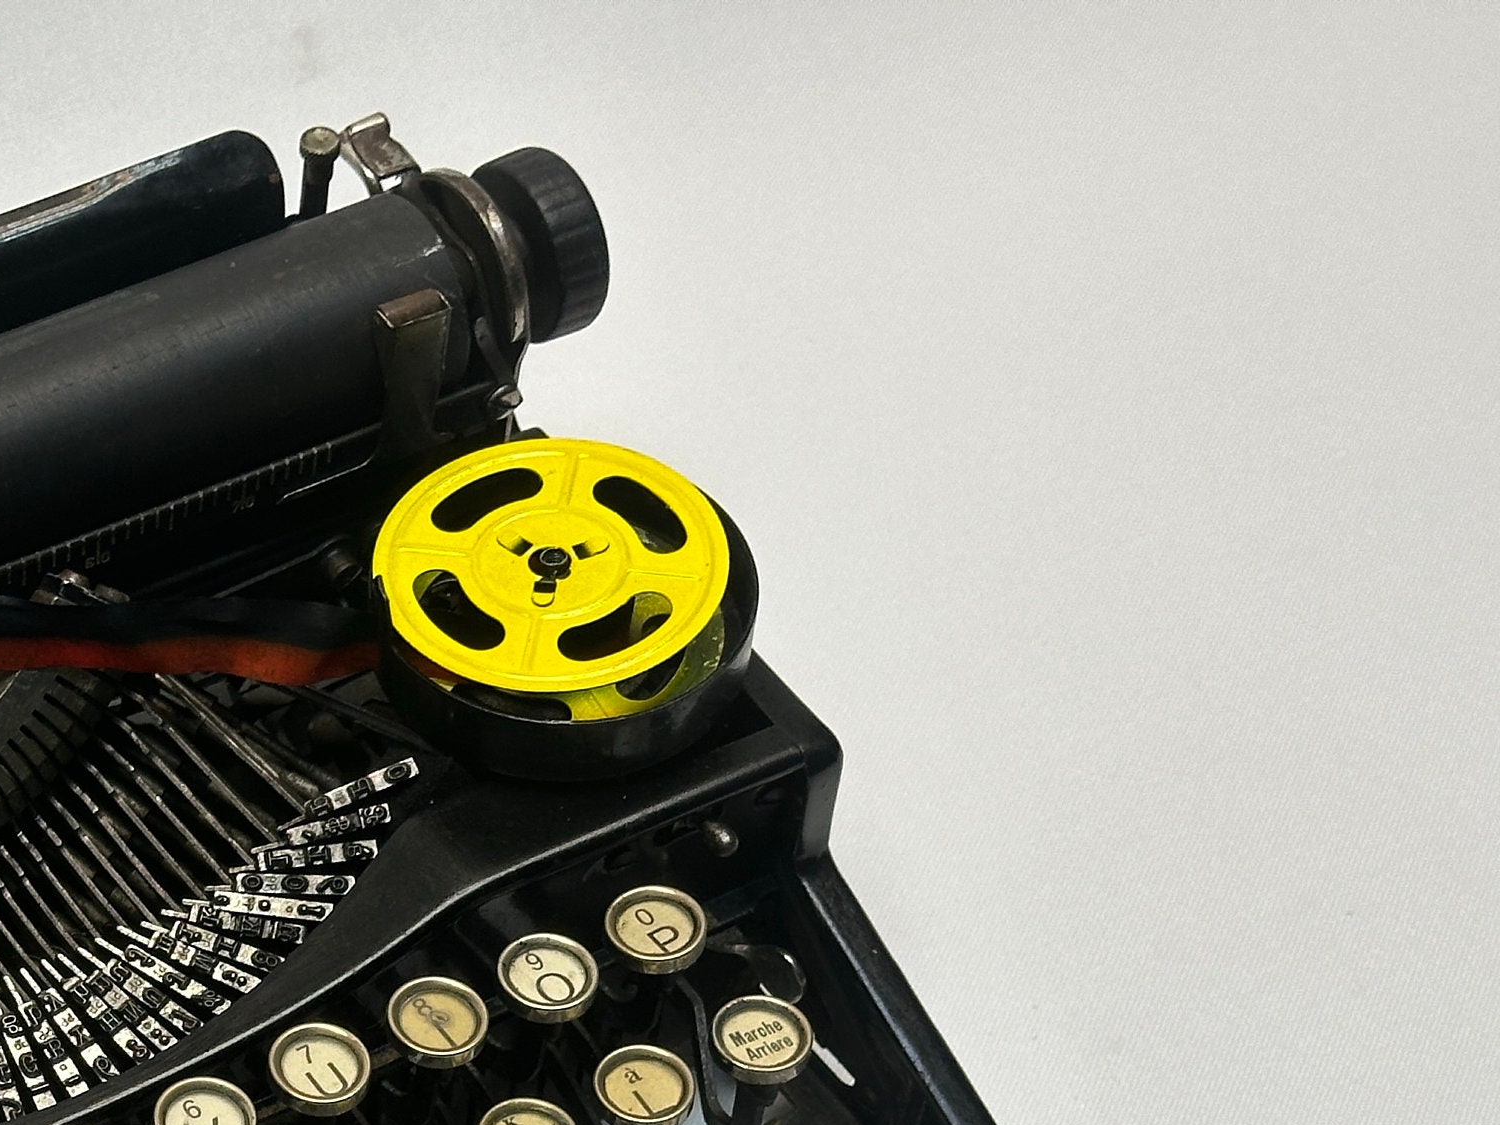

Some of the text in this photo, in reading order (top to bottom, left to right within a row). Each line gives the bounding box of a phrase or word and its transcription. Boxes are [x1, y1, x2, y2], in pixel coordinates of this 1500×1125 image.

[647, 925, 679, 953] P
[525, 953, 543, 970] 9
[536, 972, 574, 1005] O
[296, 1044, 312, 1064] 7
[305, 1062, 348, 1099] U
[183, 1100, 200, 1118] 6
